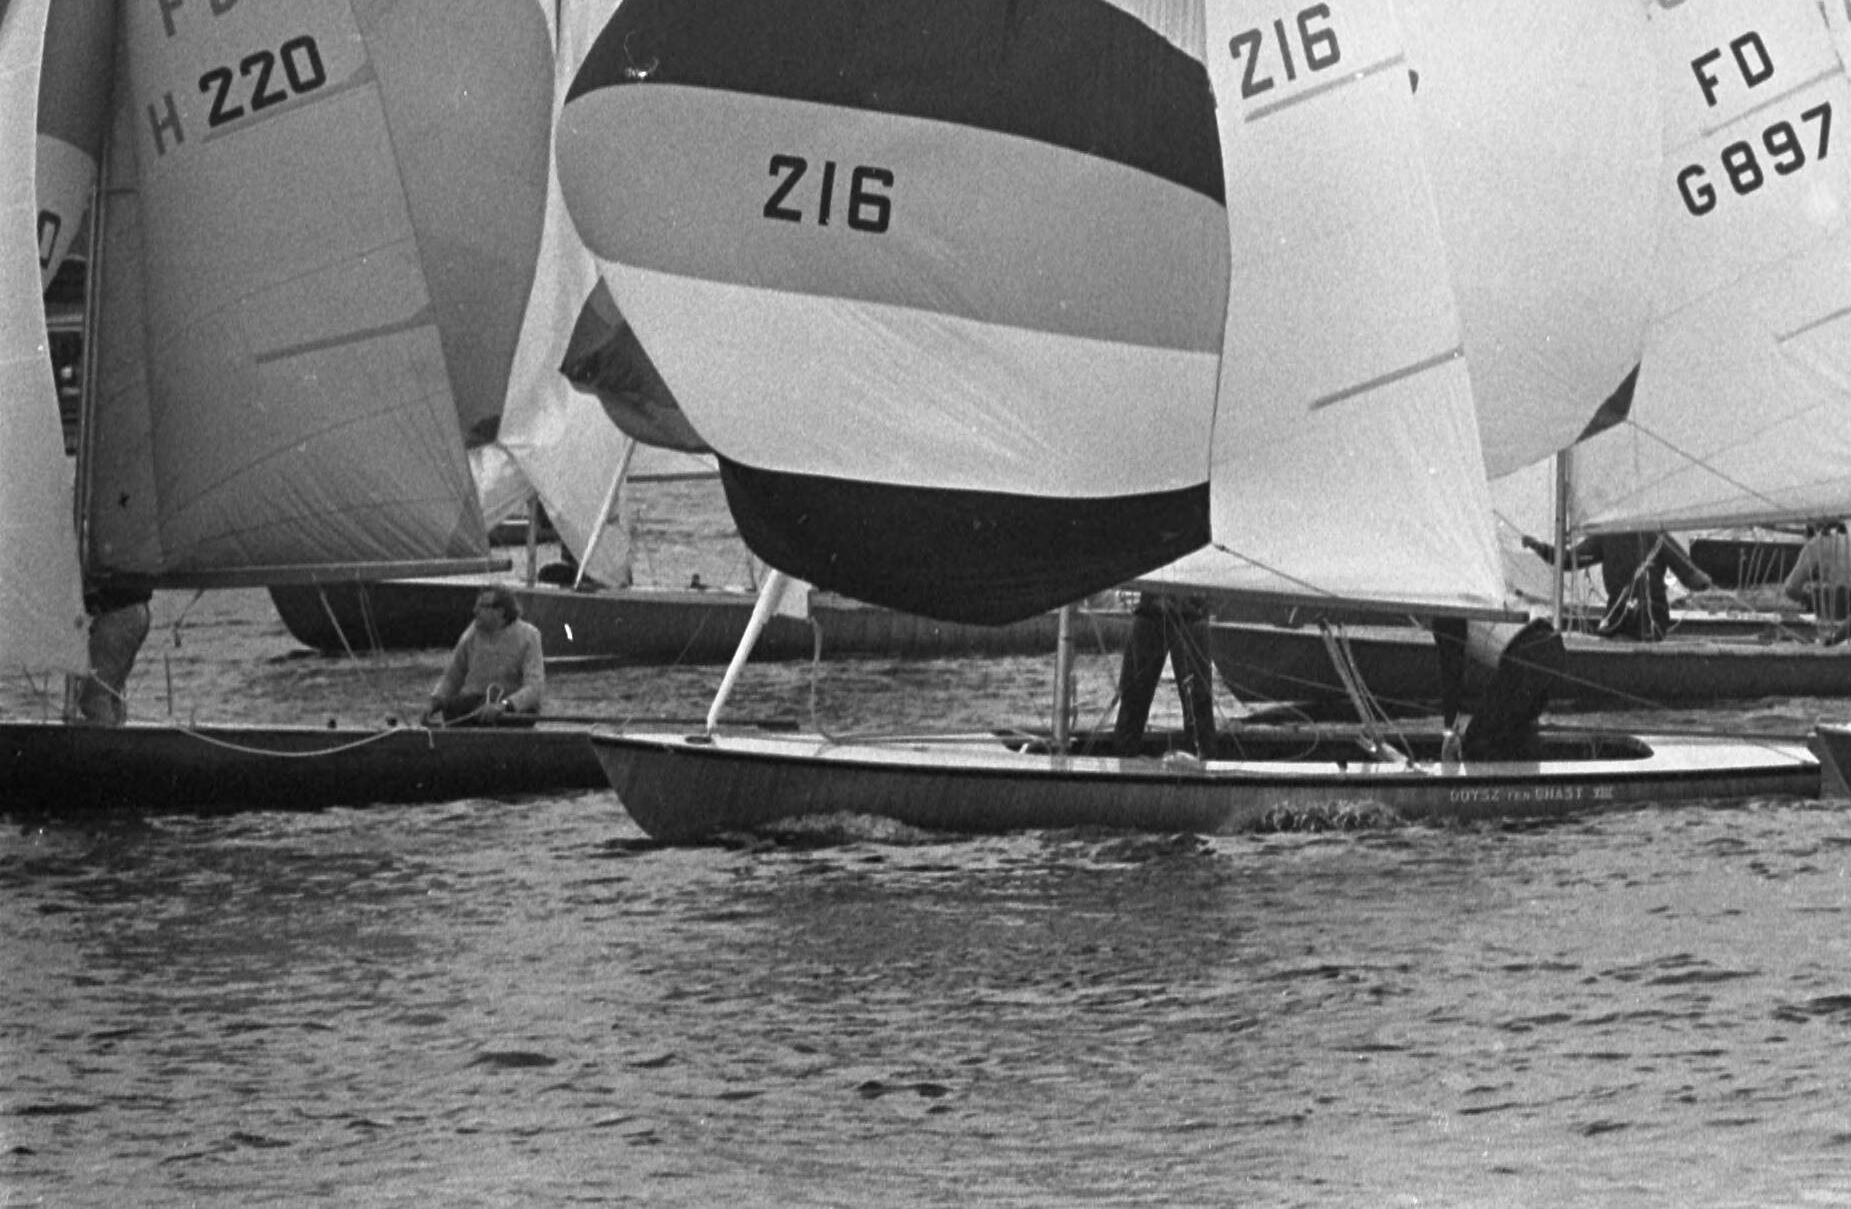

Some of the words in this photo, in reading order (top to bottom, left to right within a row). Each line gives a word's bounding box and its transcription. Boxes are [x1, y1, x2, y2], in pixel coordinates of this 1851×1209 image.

[199, 35, 327, 128] 220
[1229, 2, 1341, 100] 216
[1691, 31, 1774, 107] FD
[762, 154, 895, 233] 216
